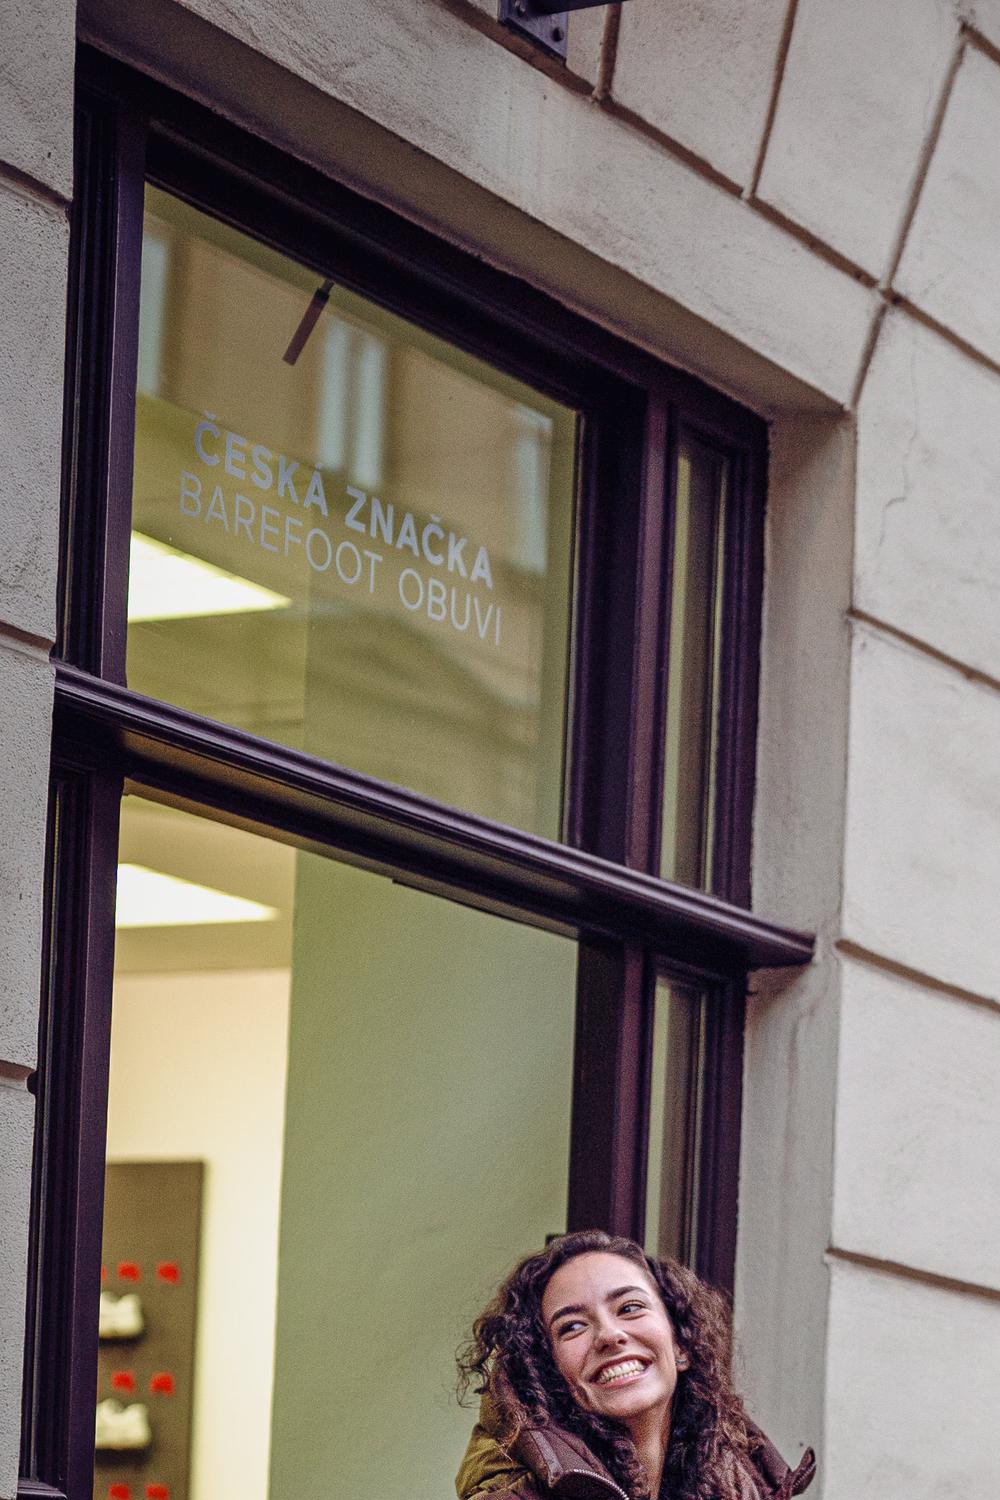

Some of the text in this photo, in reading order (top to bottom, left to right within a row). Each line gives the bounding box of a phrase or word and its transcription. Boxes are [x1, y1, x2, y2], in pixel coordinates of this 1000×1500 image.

[179, 470, 500, 645] BAREFOOT OBUVI
[194, 411, 493, 590] ČESKÁ ZNAČKA
